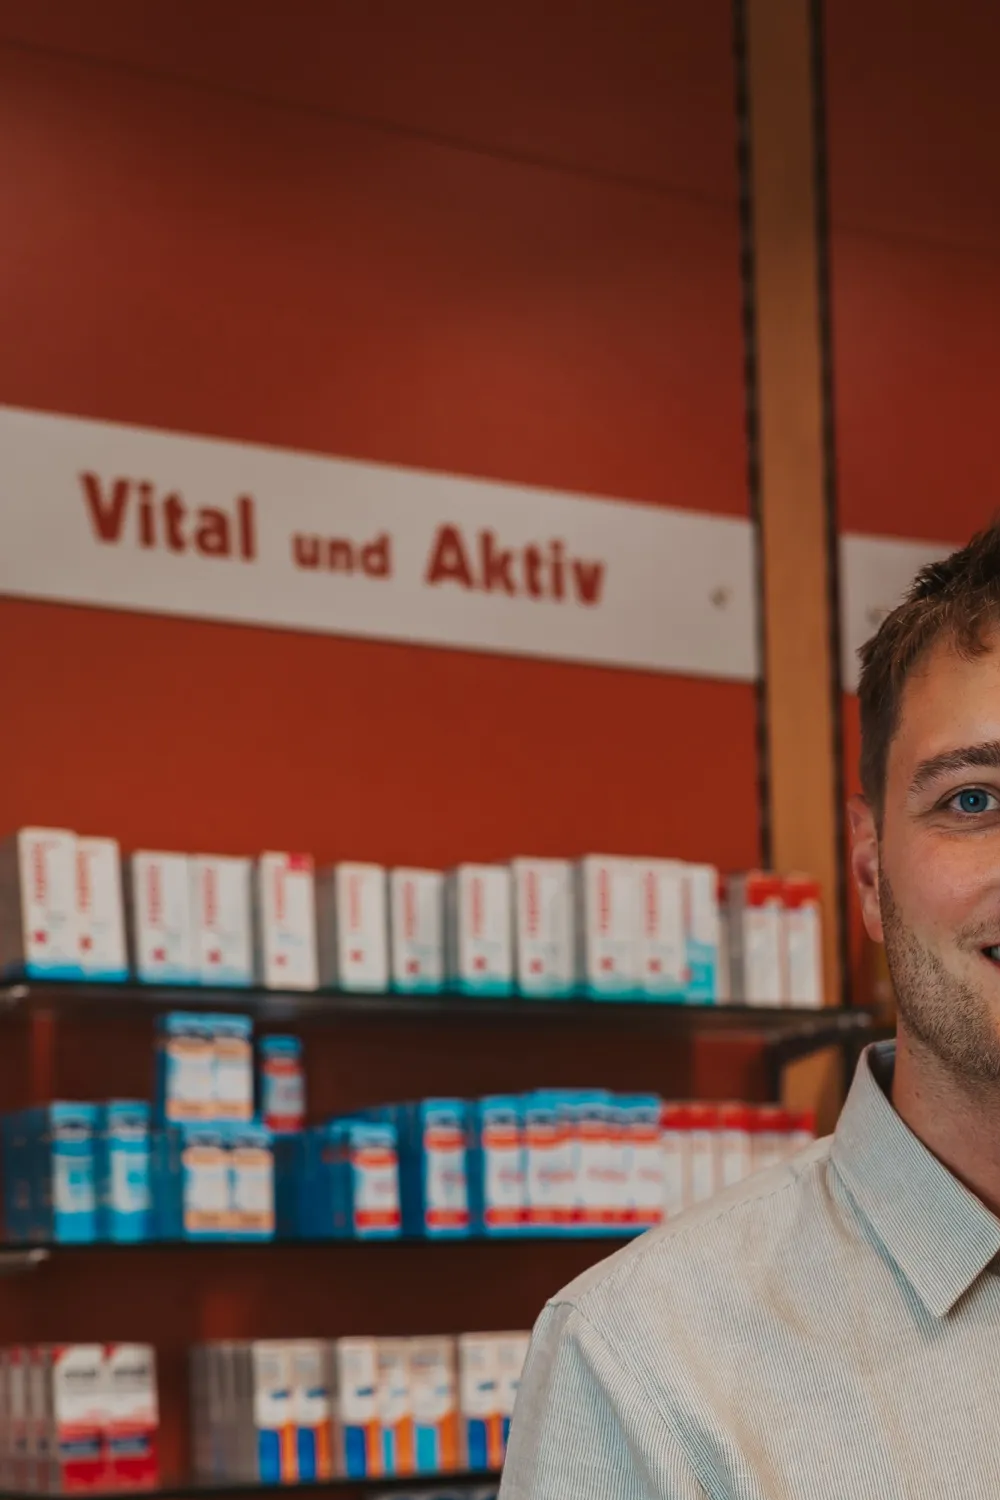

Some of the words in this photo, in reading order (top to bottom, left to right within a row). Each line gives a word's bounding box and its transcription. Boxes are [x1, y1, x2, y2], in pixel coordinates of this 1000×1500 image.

[80, 471, 255, 563] Vital
[292, 532, 391, 580] und
[424, 524, 606, 605] Aktiv
